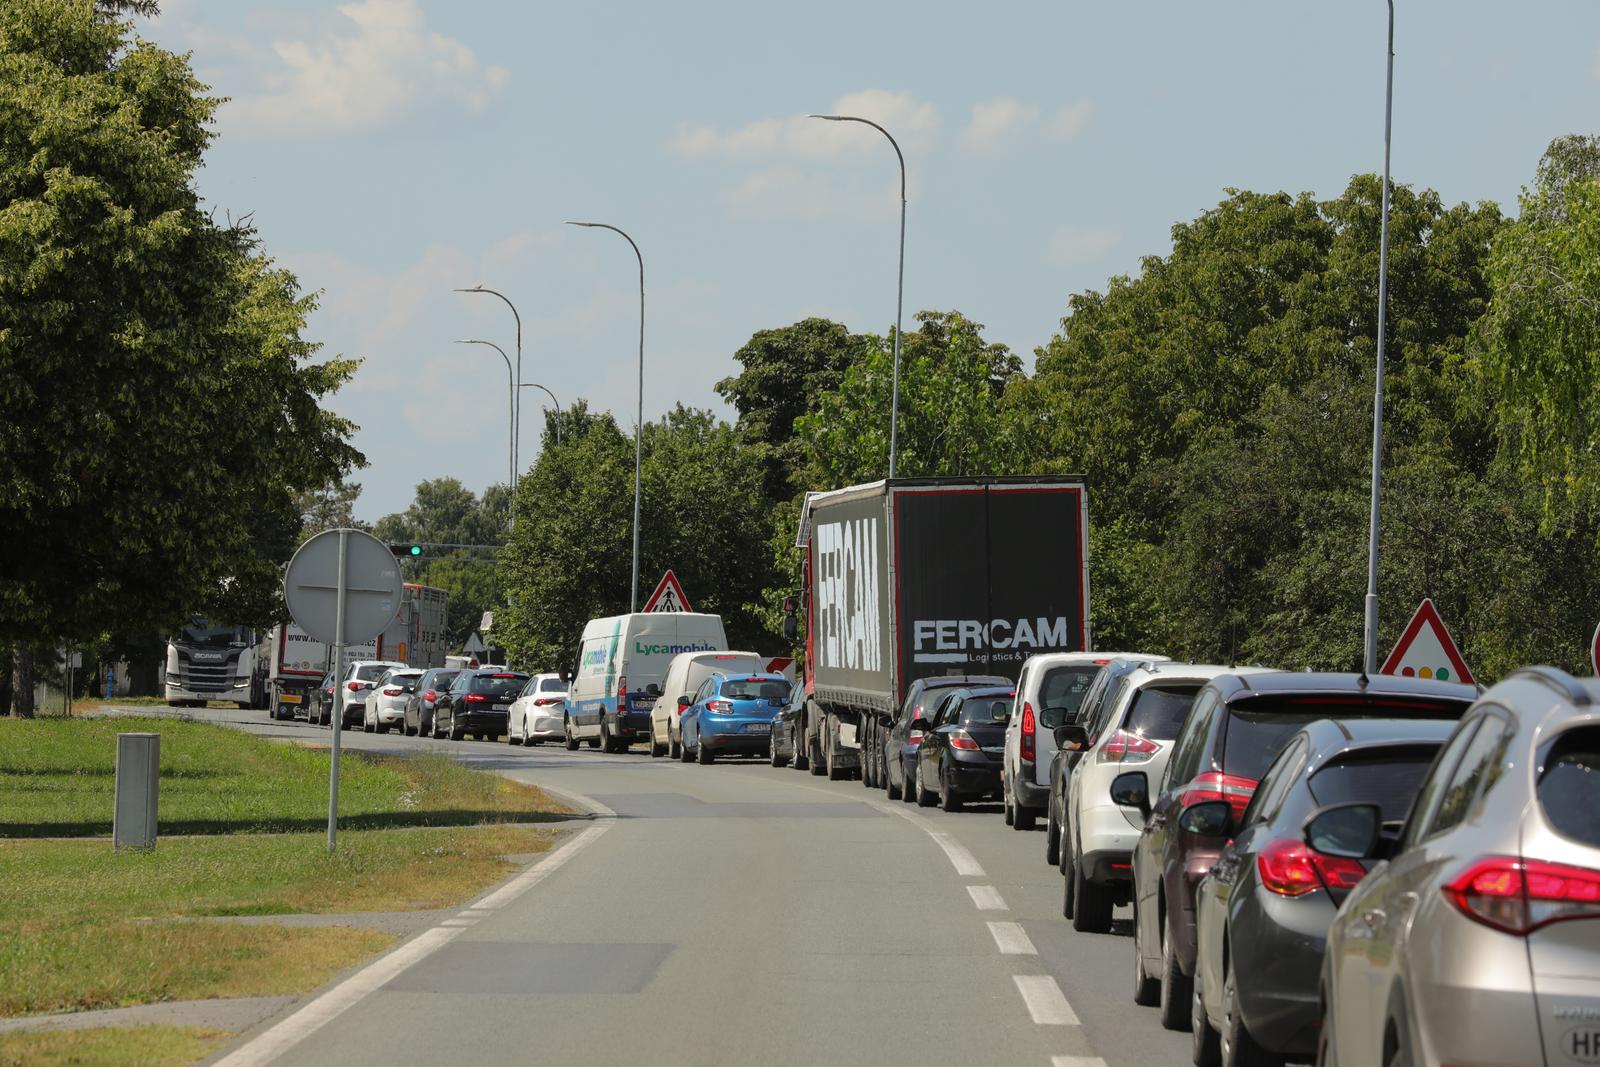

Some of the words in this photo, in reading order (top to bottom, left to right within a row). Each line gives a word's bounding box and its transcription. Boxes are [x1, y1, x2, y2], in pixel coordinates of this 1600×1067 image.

[818, 518, 881, 671] FERCAM
[914, 617, 1067, 650] FERCAM
[636, 642, 717, 655] Lycamobile
[1015, 652, 1022, 660] &
